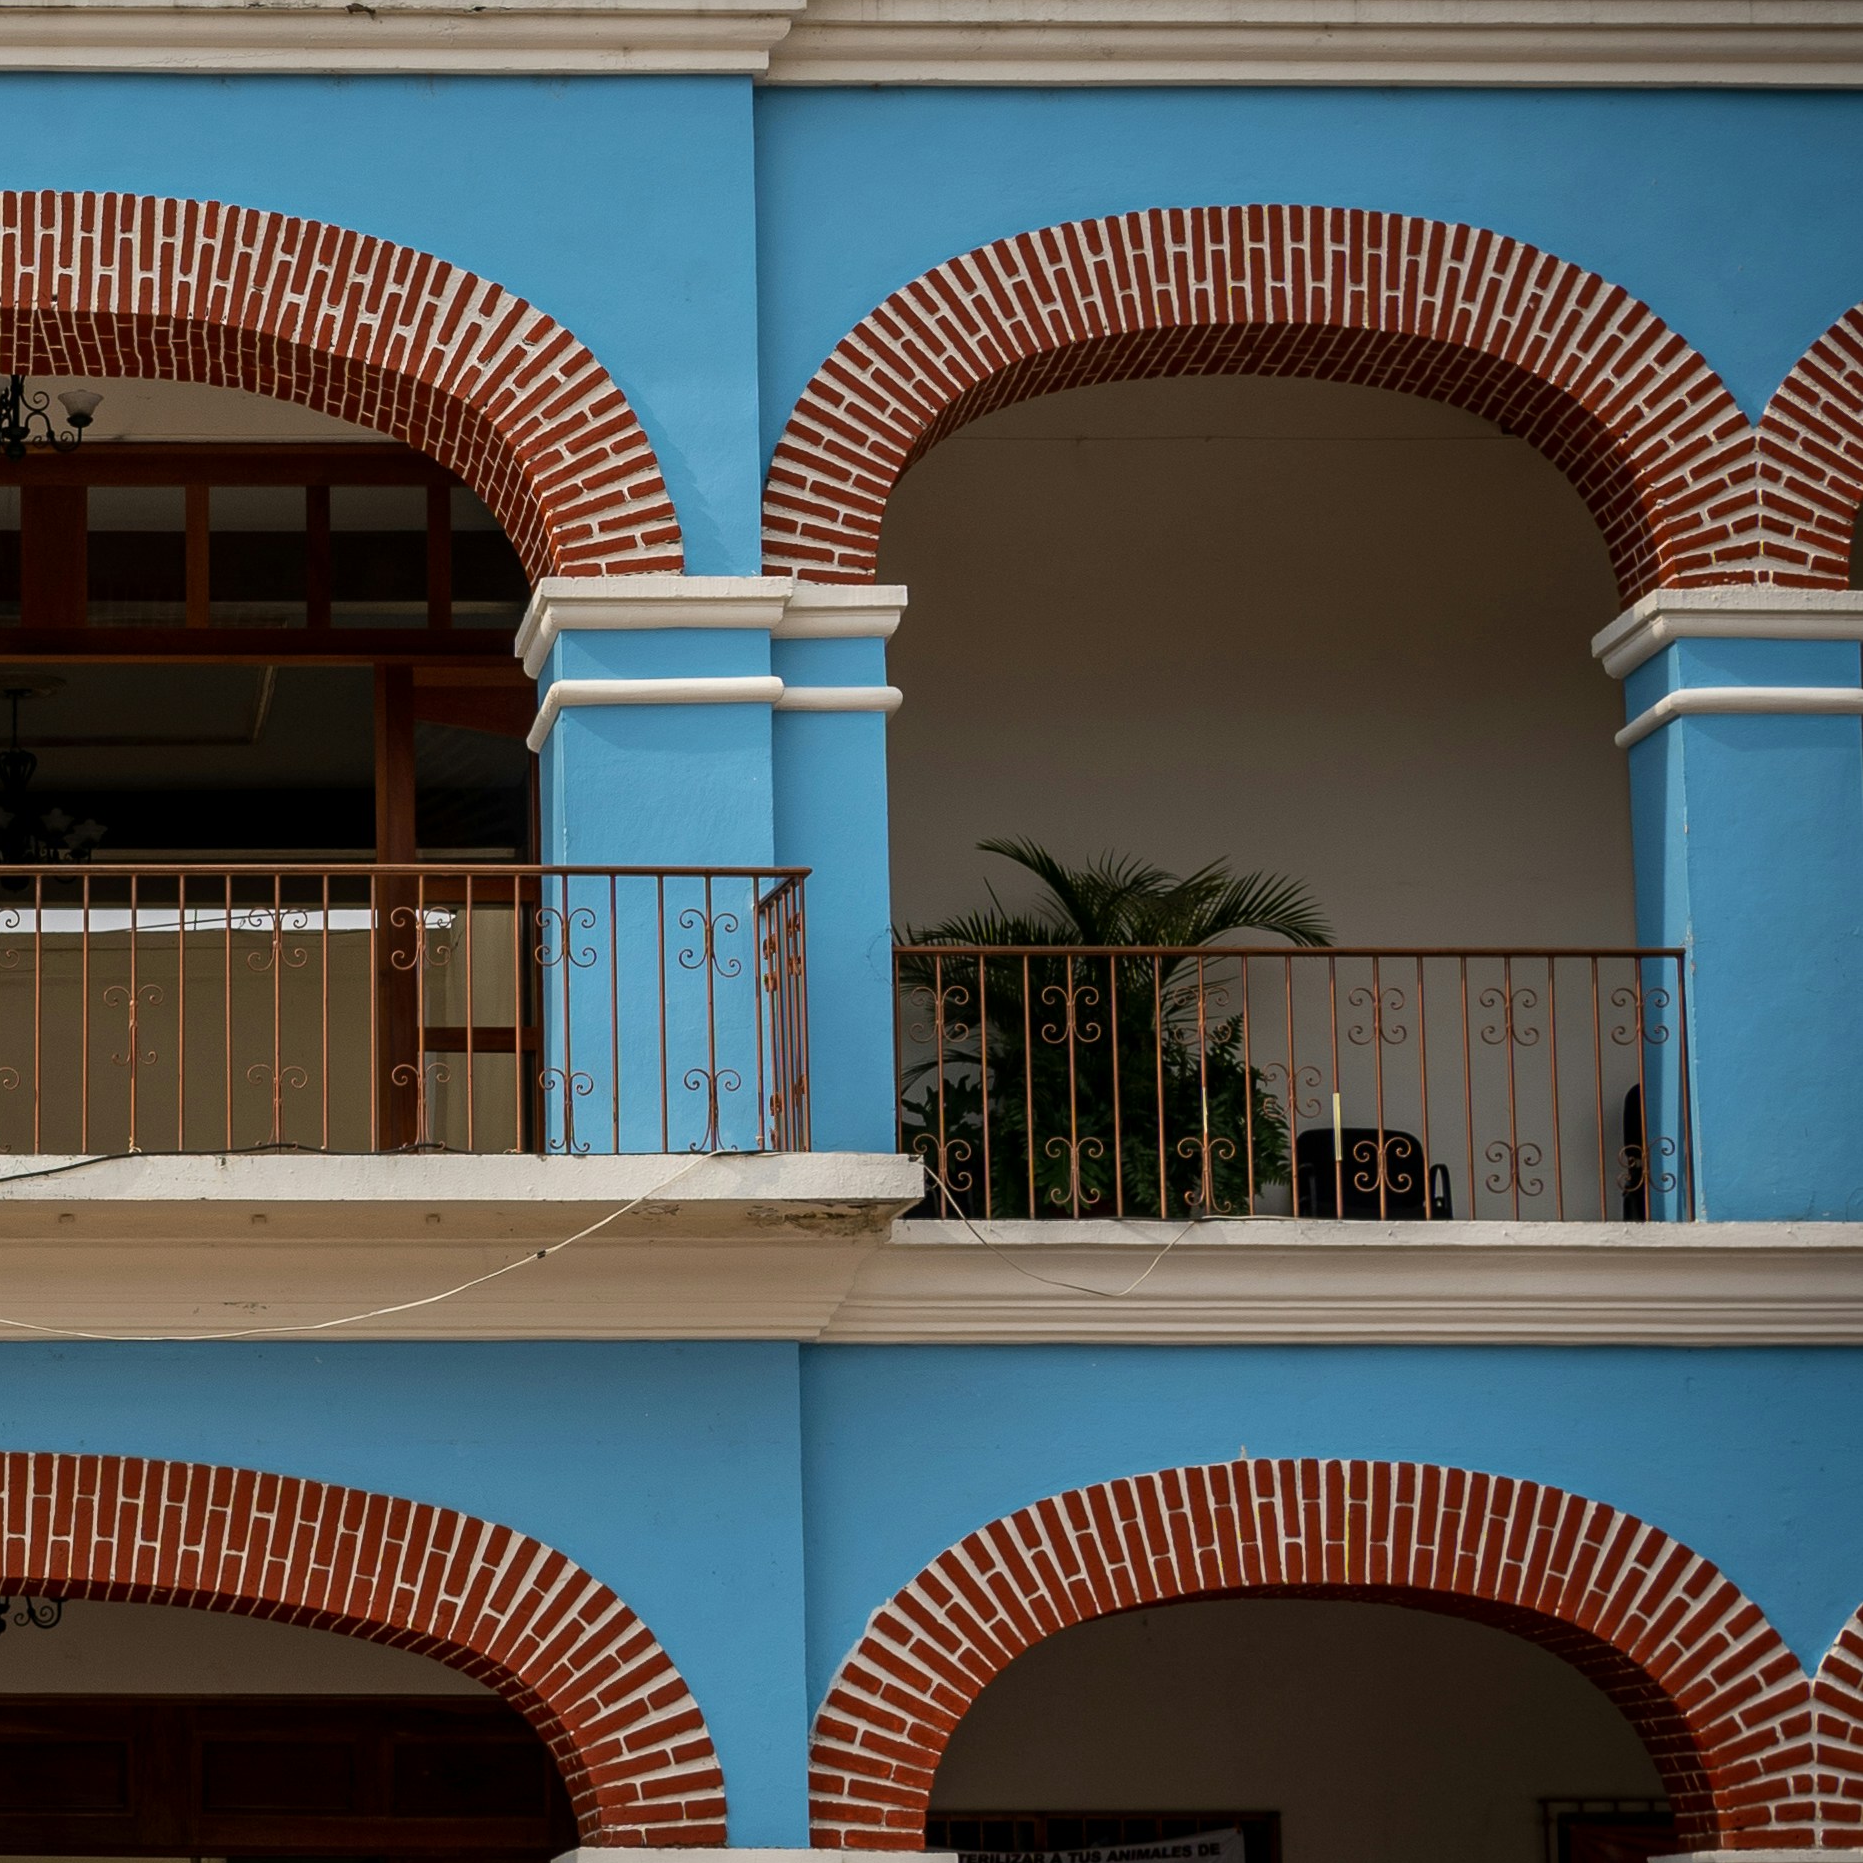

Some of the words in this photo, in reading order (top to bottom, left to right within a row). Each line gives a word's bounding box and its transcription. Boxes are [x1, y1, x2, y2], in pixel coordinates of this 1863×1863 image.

[1051, 1852, 1062, 1863] A
[1068, 1851, 1101, 1863] TUS
[1107, 1845, 1192, 1862] ANIMALES
[1198, 1843, 1220, 1856] DE
